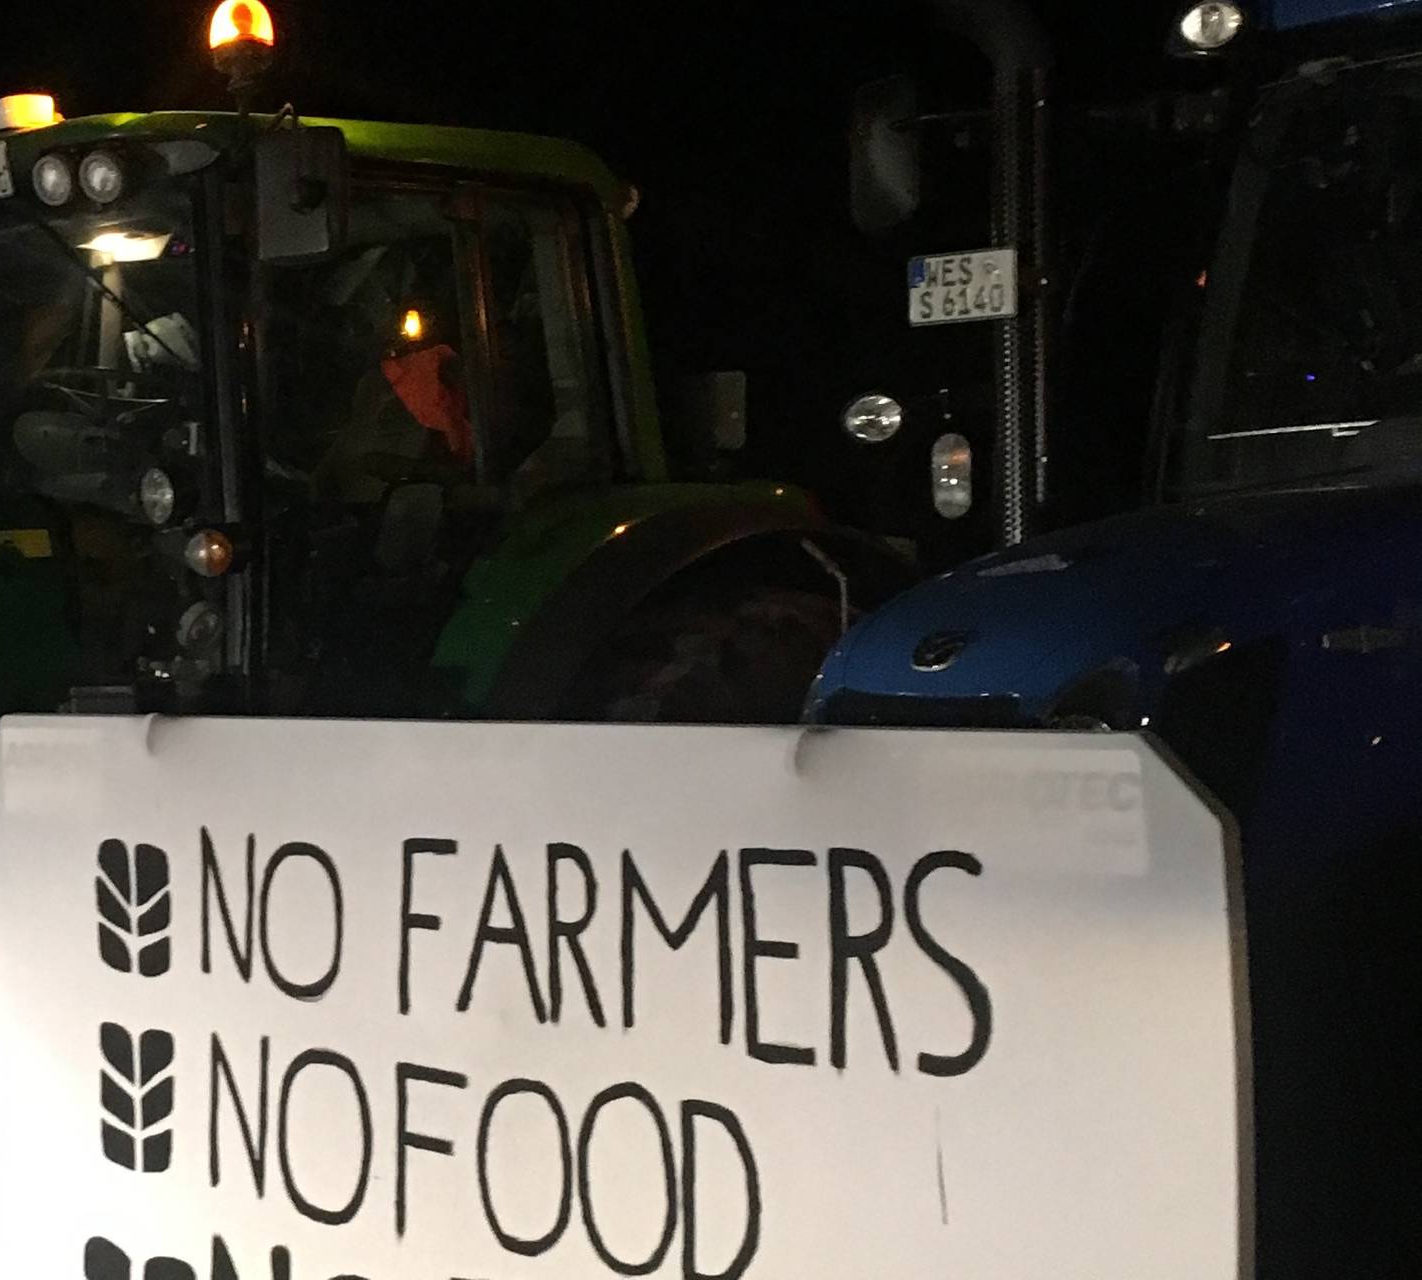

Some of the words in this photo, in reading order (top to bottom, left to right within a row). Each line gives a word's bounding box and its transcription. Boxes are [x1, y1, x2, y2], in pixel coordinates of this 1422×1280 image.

[920, 290, 933, 319] S
[944, 283, 1005, 316] 6140
[925, 256, 972, 288] WES
[200, 826, 344, 1001] NO
[396, 838, 993, 1077] FARMERS
[210, 1032, 373, 1225] NO
[395, 1061, 762, 1280] FOOD
